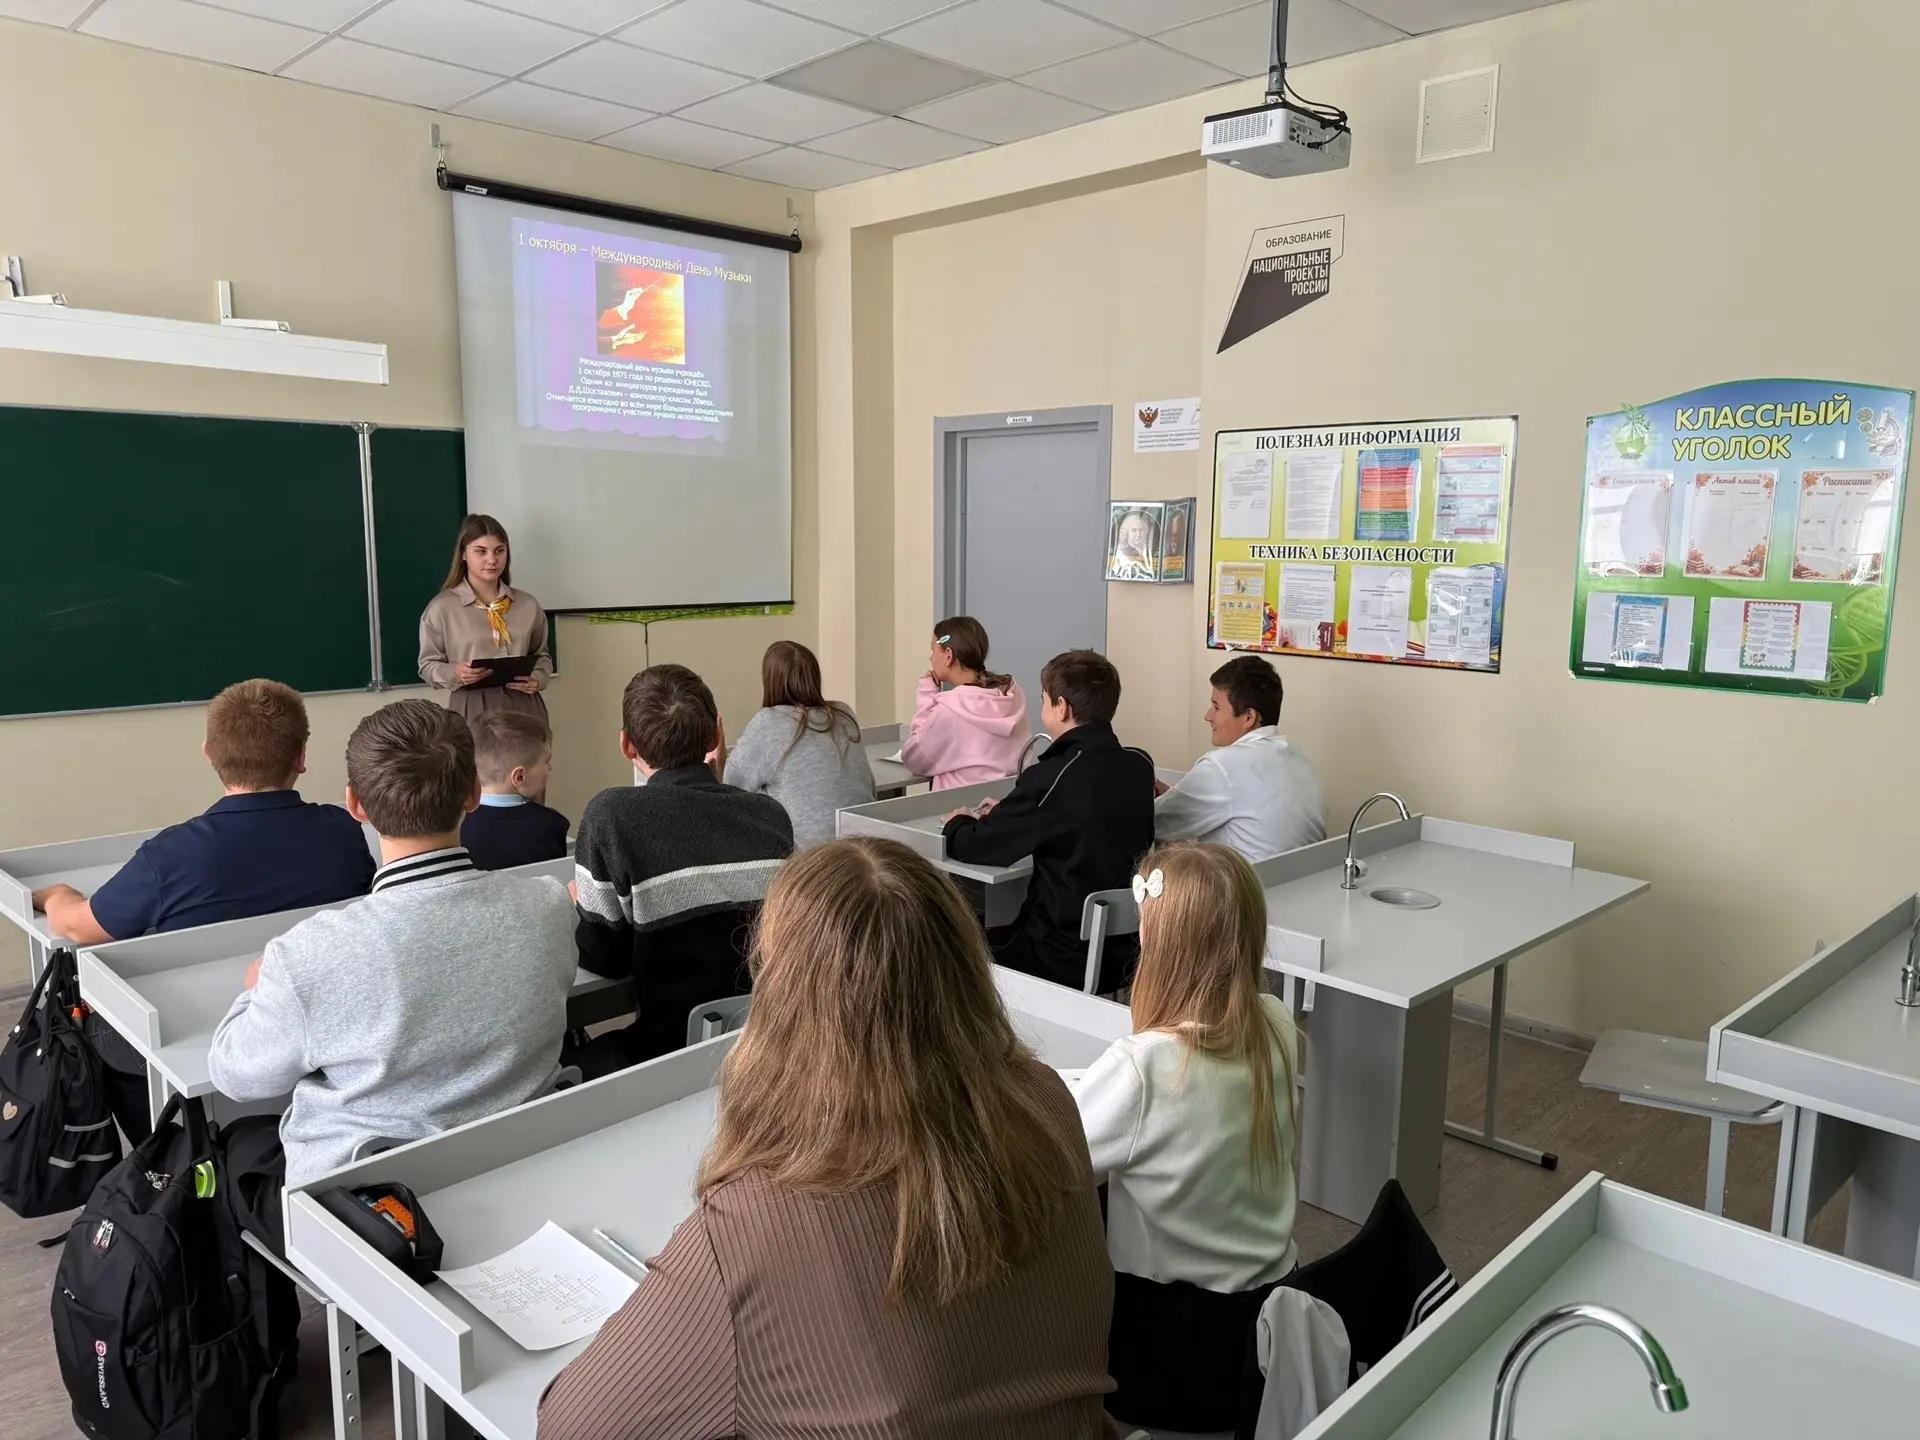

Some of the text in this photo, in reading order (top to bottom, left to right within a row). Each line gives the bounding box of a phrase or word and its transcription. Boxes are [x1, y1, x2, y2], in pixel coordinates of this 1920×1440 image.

[1266, 229, 1332, 248] ОБРАЗОВАНИЕ
[518, 234, 525, 246] 1
[529, 236, 577, 254] октября
[591, 245, 682, 272] Международный
[686, 262, 712, 278] День
[714, 266, 752, 284] Музыки
[1253, 250, 1330, 274] НАЦИОНАЛЬНЫЕ
[1284, 264, 1328, 283] ПРОЕКТЫ
[1292, 278, 1328, 296] РОССИИ
[580, 358, 634, 370] Международный
[584, 368, 610, 378] октября
[612, 370, 628, 379] 1975
[629, 374, 644, 382] года
[616, 382, 658, 392] инициаторов
[695, 388, 708, 396] был
[1674, 393, 1851, 431] КЛАССНЫЙ
[1256, 427, 1461, 450] ПОЛЕЗНАЯ ИНФОРМАЦИЯ
[1672, 434, 1792, 462] УГОЛОК
[1712, 476, 1761, 485] Актив класса
[1822, 476, 1872, 486] Расписание
[1250, 545, 1455, 564] ТЕХНИКА БЕЗОПАСНОСТИ
[98, 1356, 110, 1408] SWISSLAND
